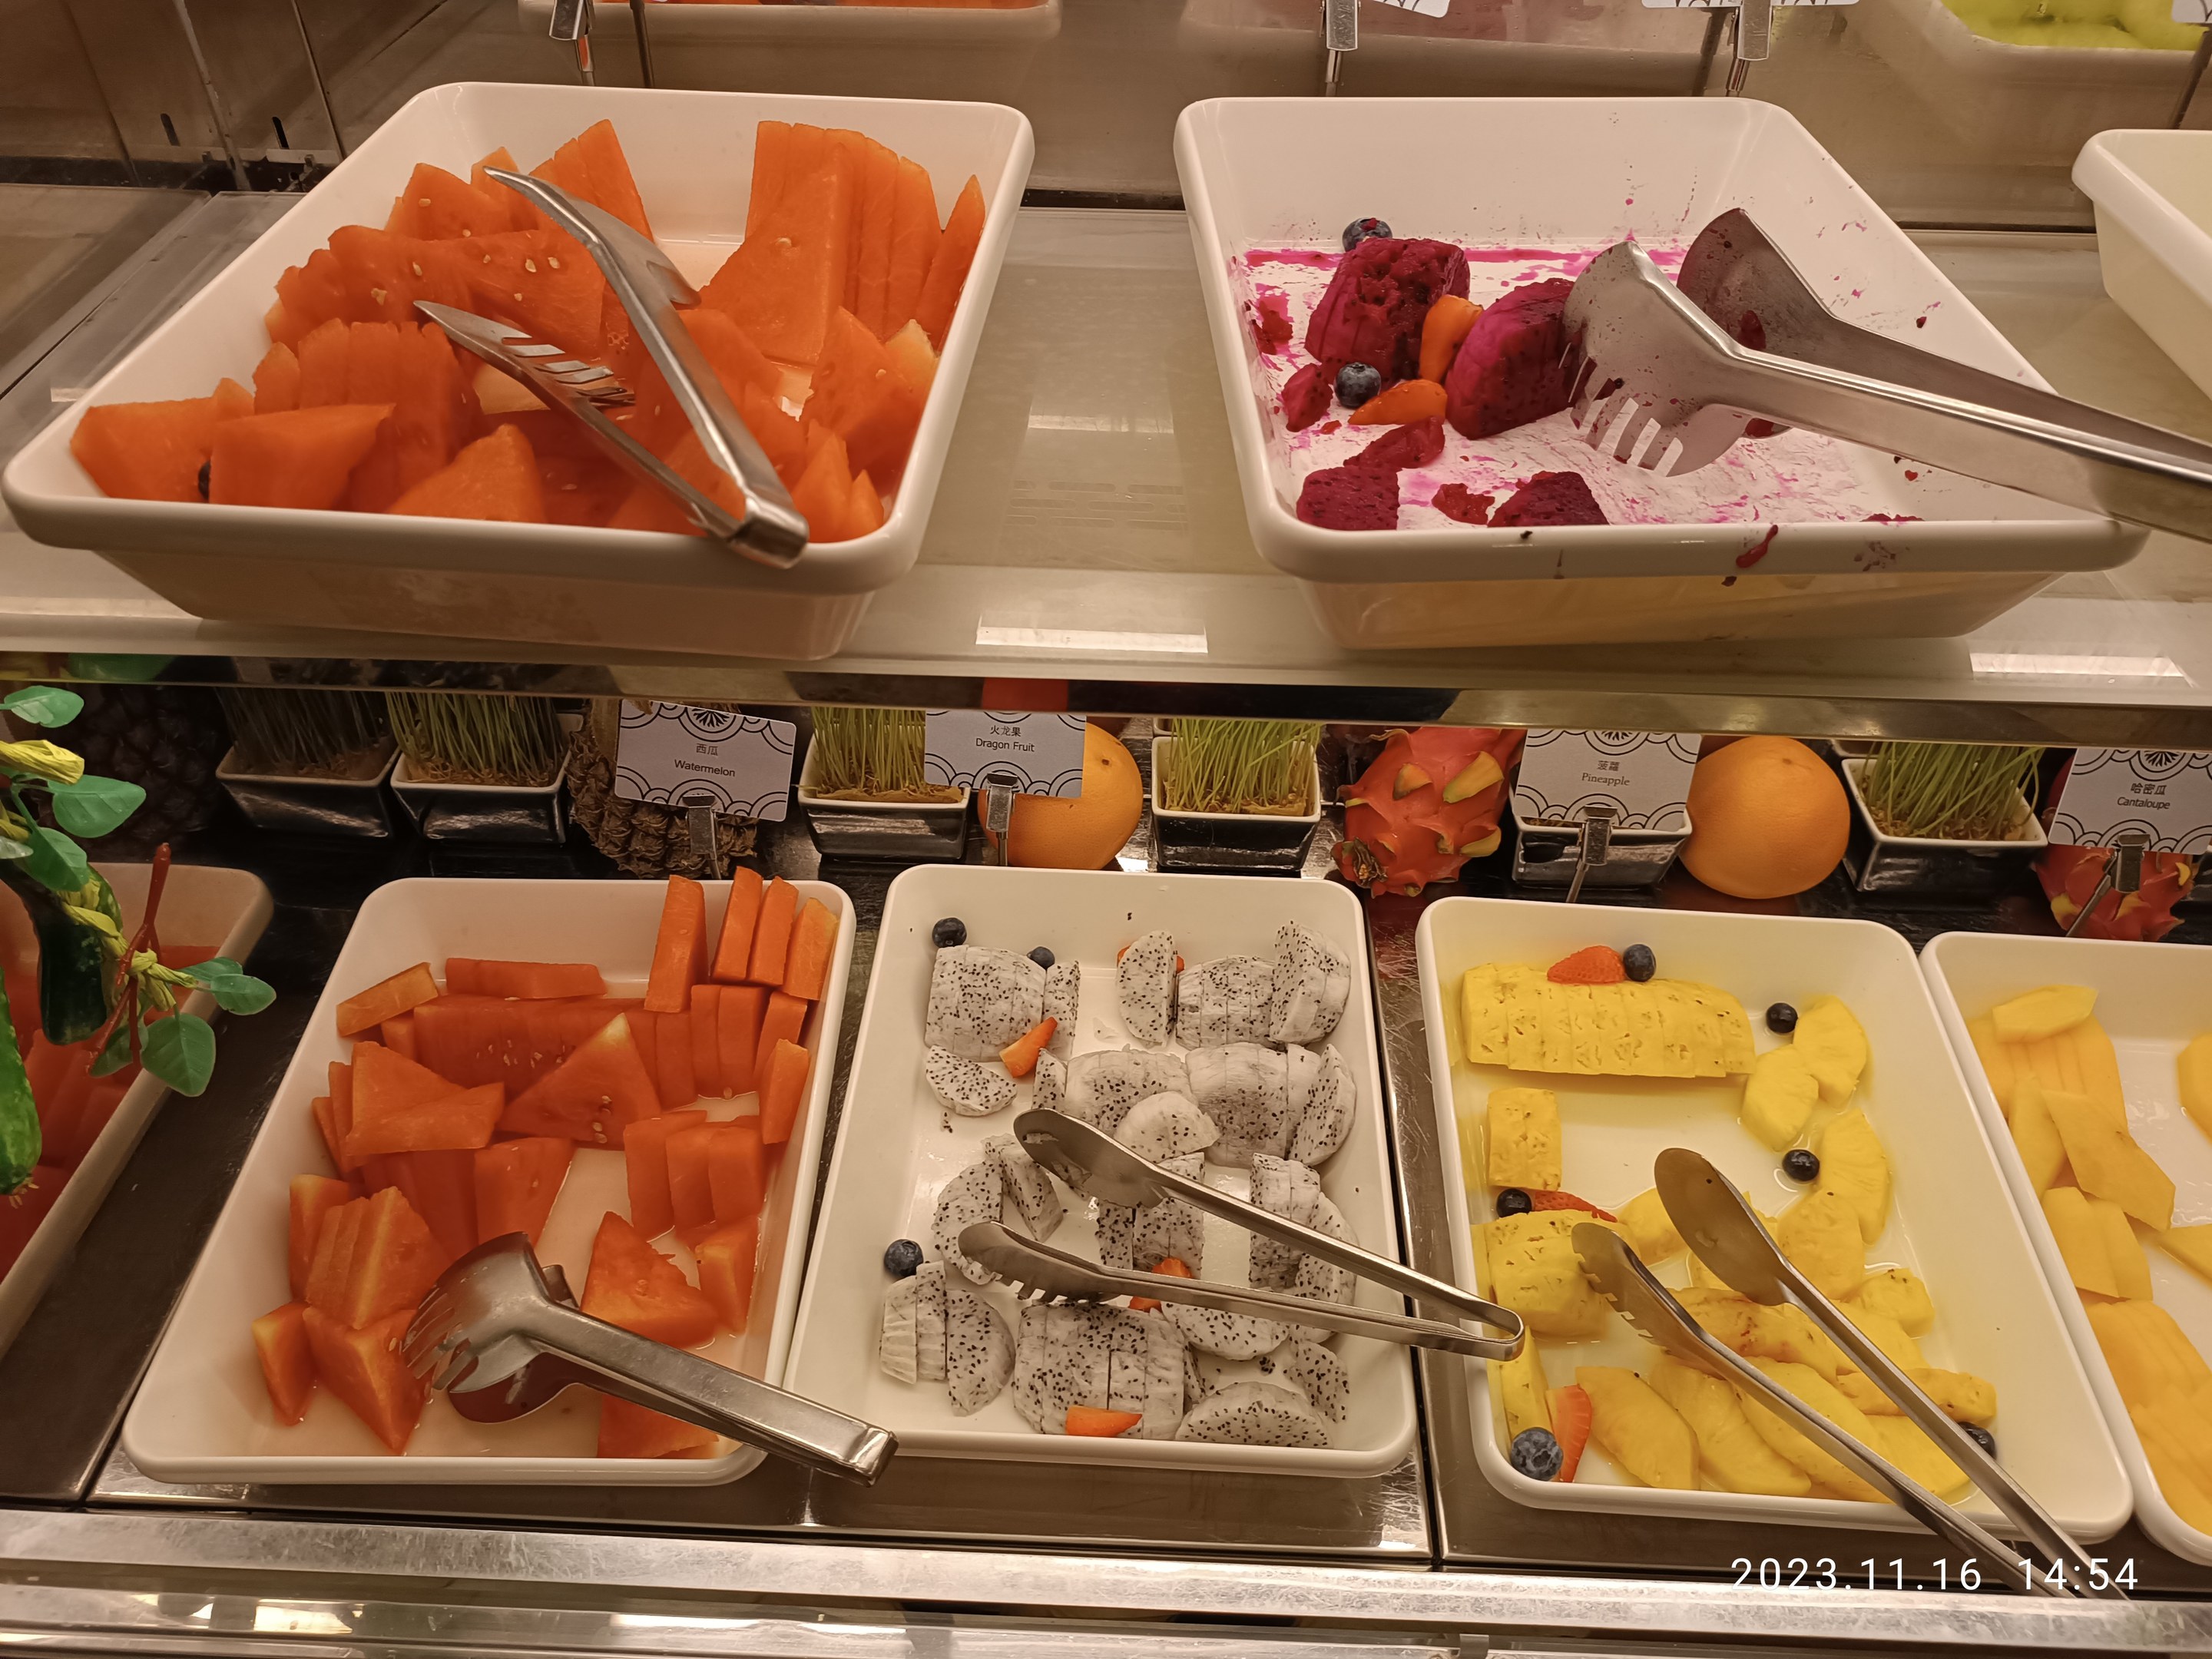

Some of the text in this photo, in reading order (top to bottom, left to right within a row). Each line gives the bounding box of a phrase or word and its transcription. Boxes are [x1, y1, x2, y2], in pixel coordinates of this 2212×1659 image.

[989, 724, 1022, 737] 火龙果
[696, 743, 719, 757] 西瓜
[975, 737, 1035, 752] Dragon Fruit
[674, 759, 736, 777] Watermelon
[1581, 772, 1631, 787] Pineapple
[2130, 782, 2167, 796] 哈密瓜
[2117, 796, 2171, 810] Cantaloupe
